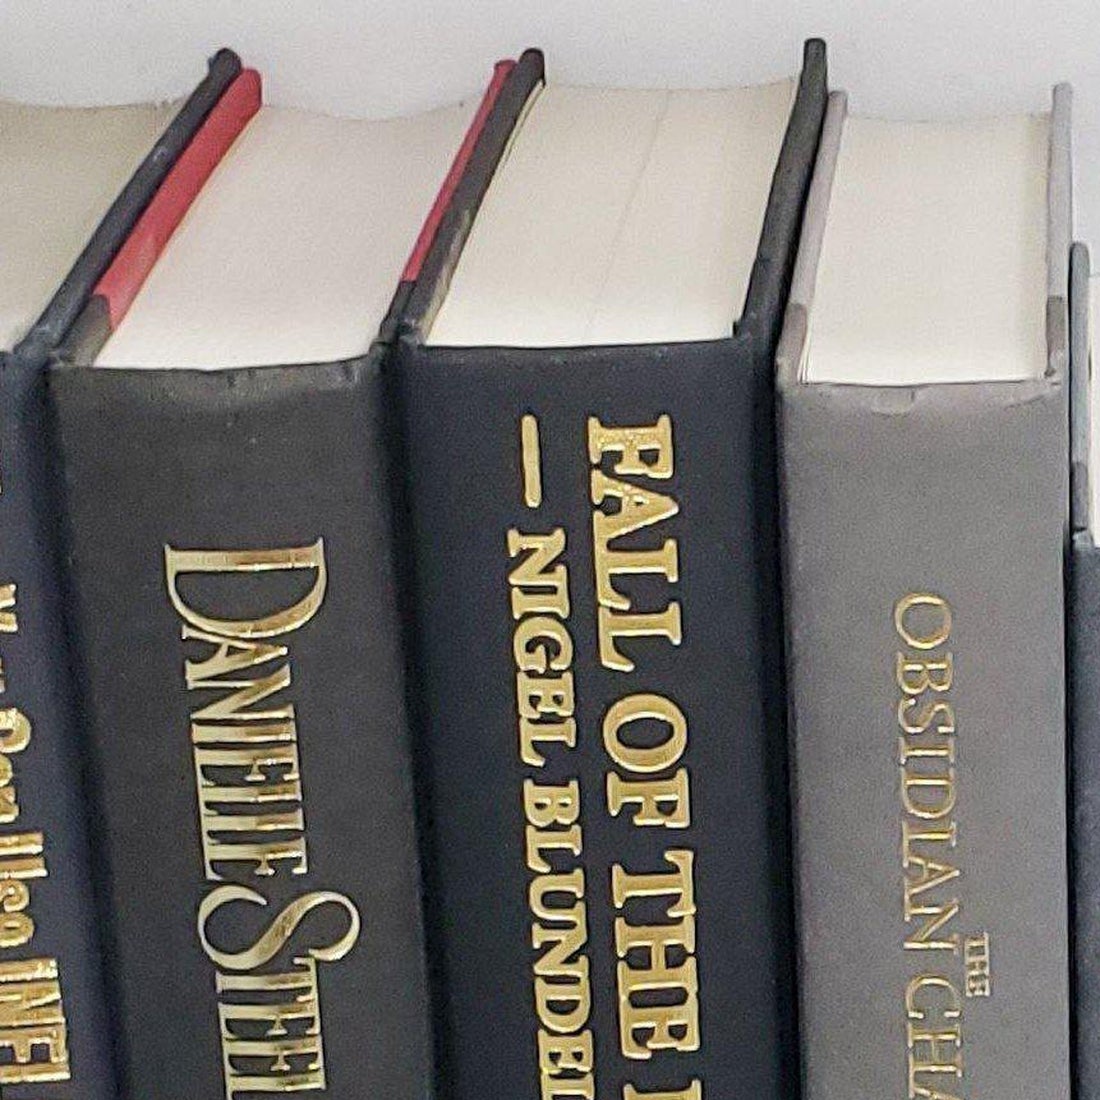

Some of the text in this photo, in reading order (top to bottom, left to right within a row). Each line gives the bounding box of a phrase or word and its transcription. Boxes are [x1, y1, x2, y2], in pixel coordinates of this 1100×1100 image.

[508, 529, 576, 766] NIGEL
[588, 415, 681, 672] FALL
[165, 538, 326, 880] DANIELLE
[603, 695, 690, 828] OF
[893, 591, 960, 954] OBSIDIAN
[612, 850, 700, 1059] THE
[964, 931, 991, 998] THE
